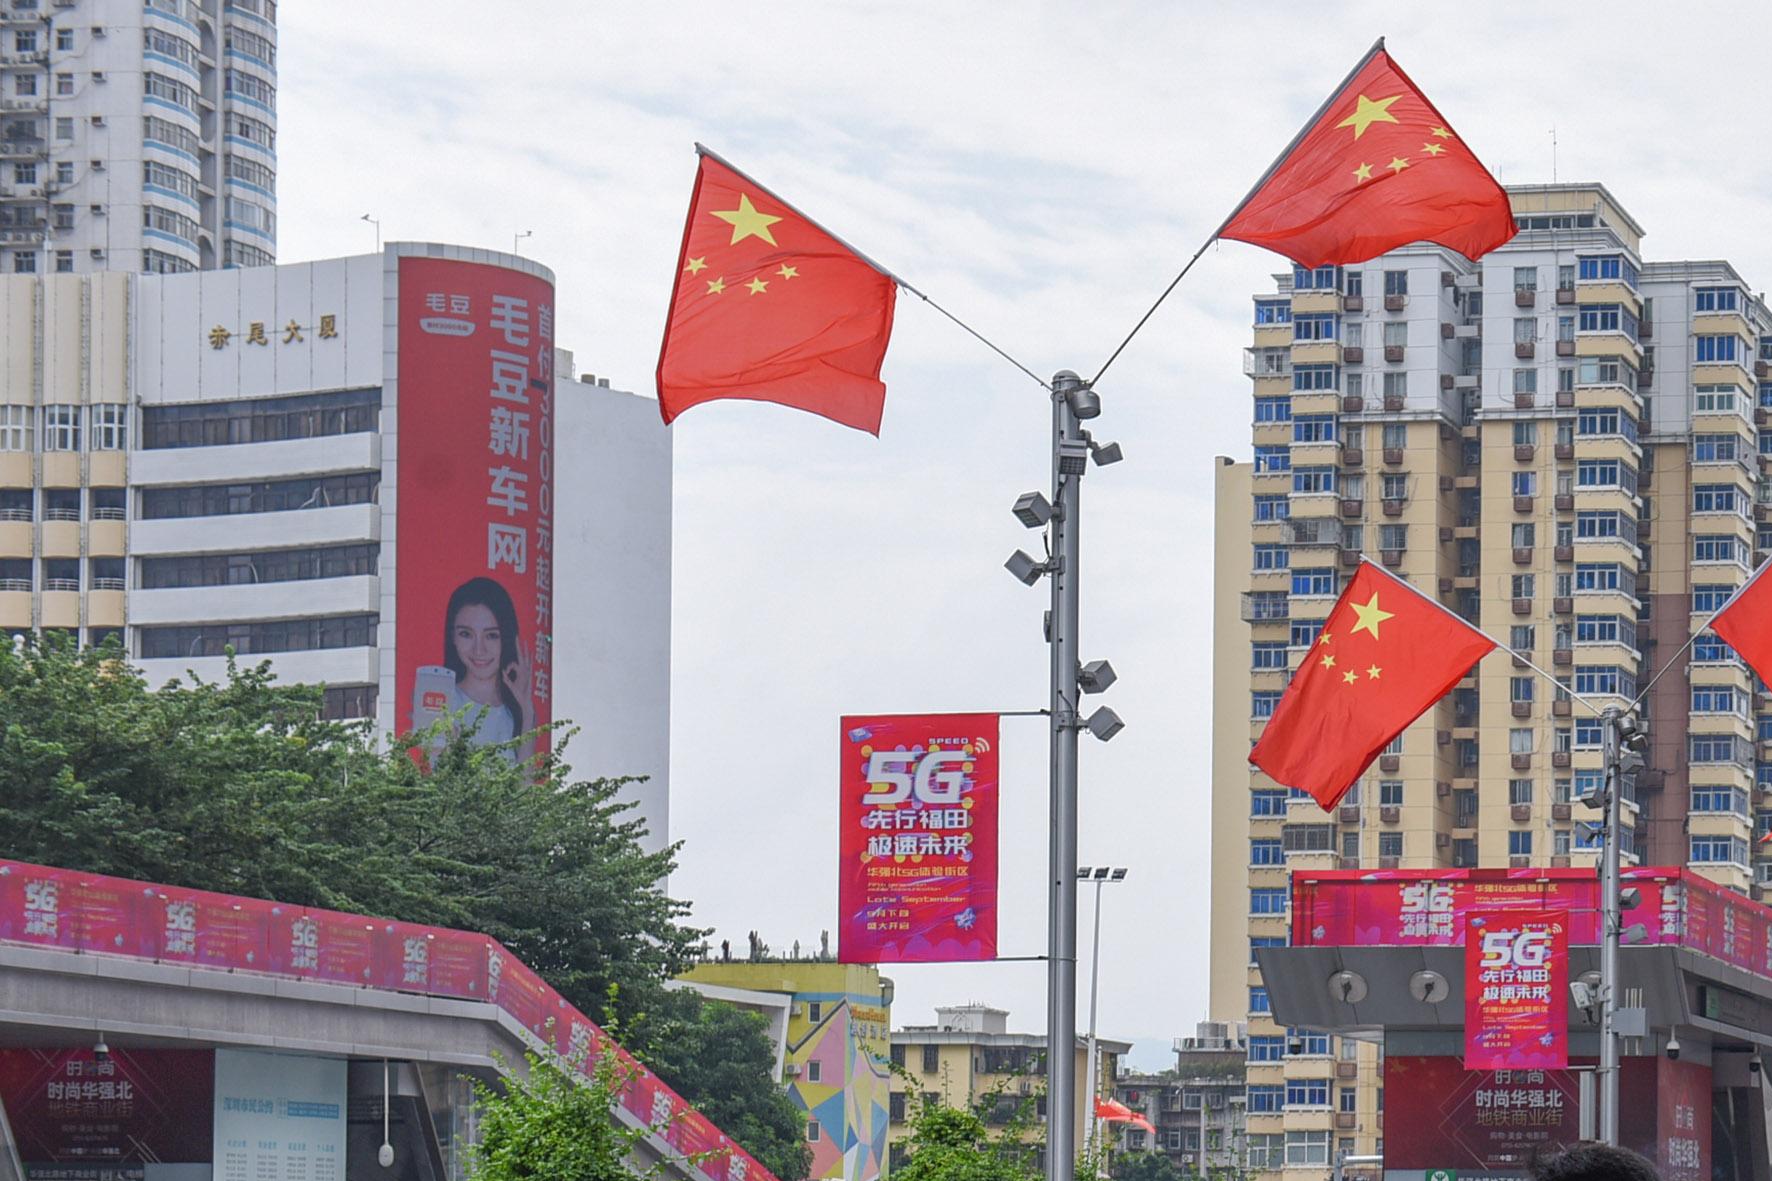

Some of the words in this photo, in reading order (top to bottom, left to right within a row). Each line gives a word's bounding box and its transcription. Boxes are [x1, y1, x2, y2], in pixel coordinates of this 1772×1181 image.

[426, 293, 470, 315] 毛豆
[208, 314, 338, 350] 赤尾大厦
[487, 294, 530, 574] 毛豆新车网
[862, 750, 971, 805] 5G
[868, 810, 968, 829] 先行福田
[868, 836, 969, 856] 极速未来
[1401, 885, 1453, 912] 5G
[1480, 931, 1550, 967] 5G
[1484, 970, 1548, 983] 先行福田
[47, 1081, 134, 1100] 时尚华强北
[1475, 1089, 1564, 1108] 时尚华强北
[1476, 1108, 1563, 1127] 地铁商业街
